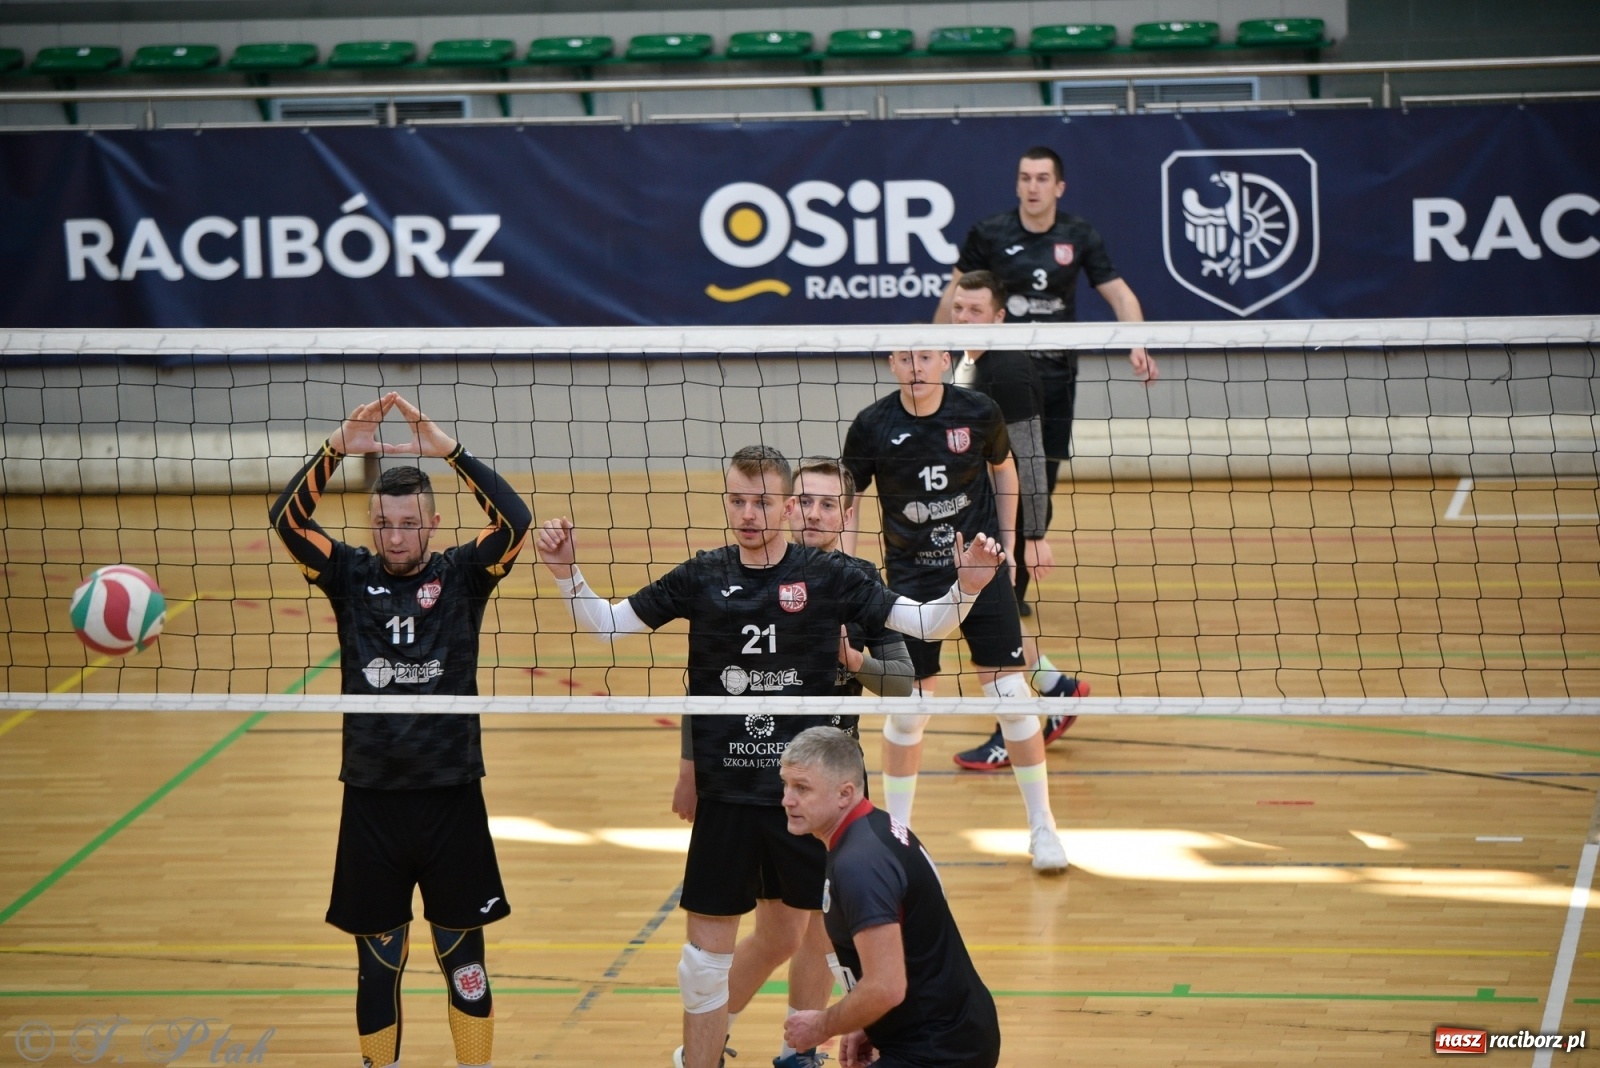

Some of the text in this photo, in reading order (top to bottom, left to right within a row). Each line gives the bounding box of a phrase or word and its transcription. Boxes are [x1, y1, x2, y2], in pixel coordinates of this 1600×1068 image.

[64, 193, 504, 281] RACIBÓRZ
[1412, 193, 1600, 262] RAC
[1032, 268, 1048, 291] 3
[918, 465, 948, 491] 15
[386, 616, 415, 644] 11
[741, 624, 777, 654] 21
[750, 668, 803, 686] DYMEL
[723, 758, 755, 768] SZKOŁA
